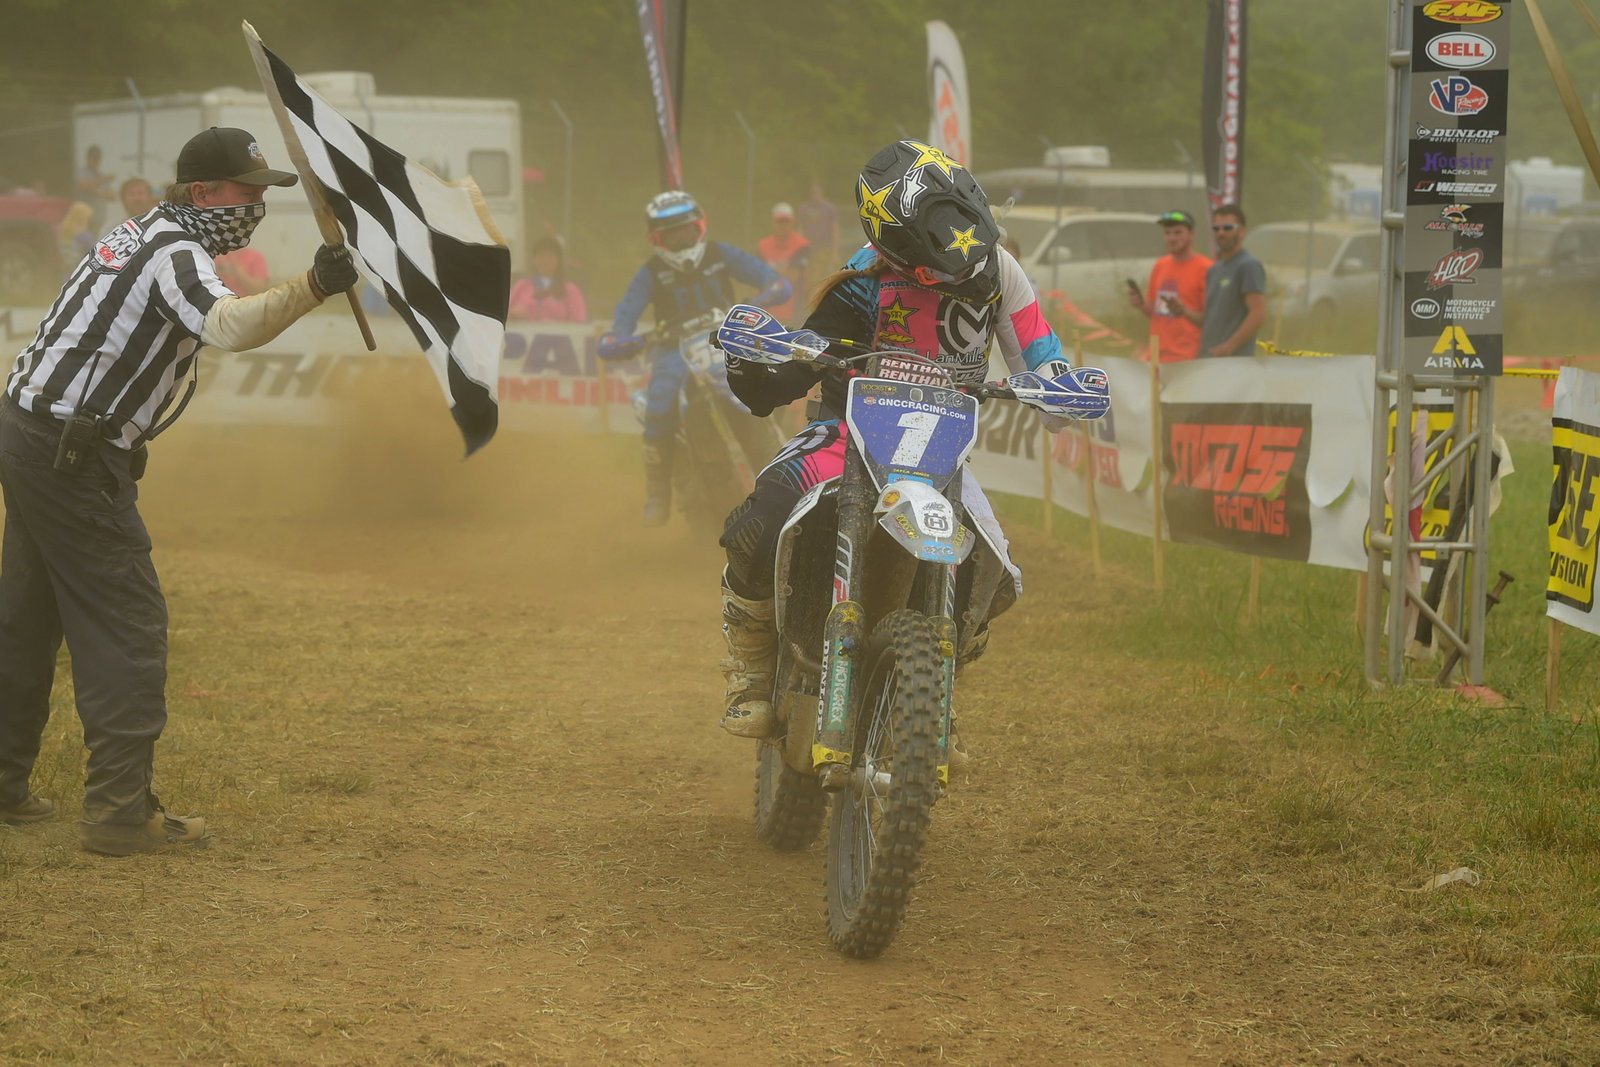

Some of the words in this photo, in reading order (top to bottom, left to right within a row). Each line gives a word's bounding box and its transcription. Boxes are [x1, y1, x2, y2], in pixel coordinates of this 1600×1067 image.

[1425, 2, 1501, 18] FMF
[1438, 42, 1485, 57] BELL
[1431, 76, 1471, 113] VP
[1432, 128, 1500, 138] DUNLOP
[1420, 152, 1494, 172] Hoosier
[1415, 304, 1436, 314] MMI
[1444, 306, 1491, 314] MECHANICS
[1446, 300, 1496, 308] MOTORCYCLE
[880, 358, 953, 377] RENTHAL
[1424, 356, 1485, 369] ARMA
[879, 369, 949, 388] RENTHAL
[878, 398, 967, 421] GNCCRACING.COM
[890, 411, 941, 467] 1
[66, 450, 77, 465] 4
[1213, 494, 1286, 536] RACING
